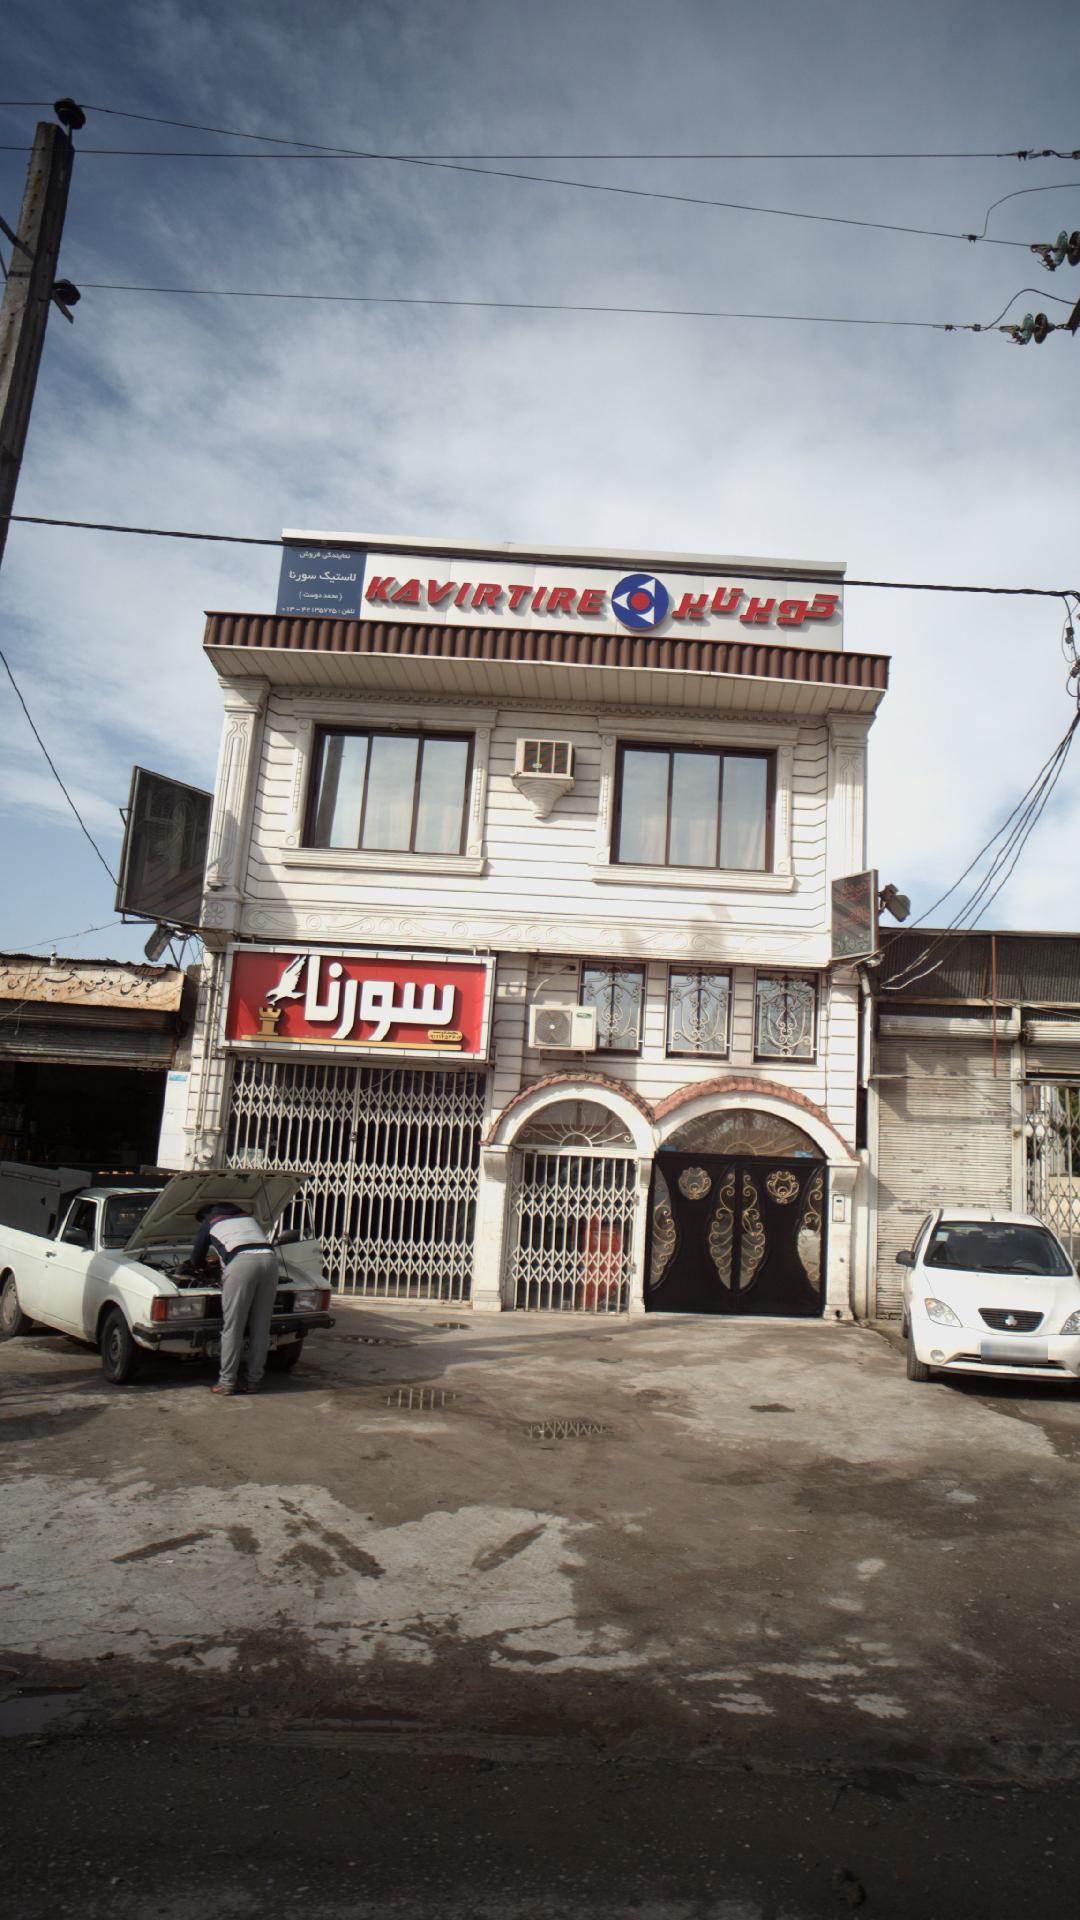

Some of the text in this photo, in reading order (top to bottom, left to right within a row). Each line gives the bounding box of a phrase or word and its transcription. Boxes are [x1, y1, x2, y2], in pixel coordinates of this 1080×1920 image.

[299, 550, 351, 560] نمایندگی فروش
[289, 570, 357, 584] لاستیک سورنا
[304, 955, 455, 1042] سورنا
